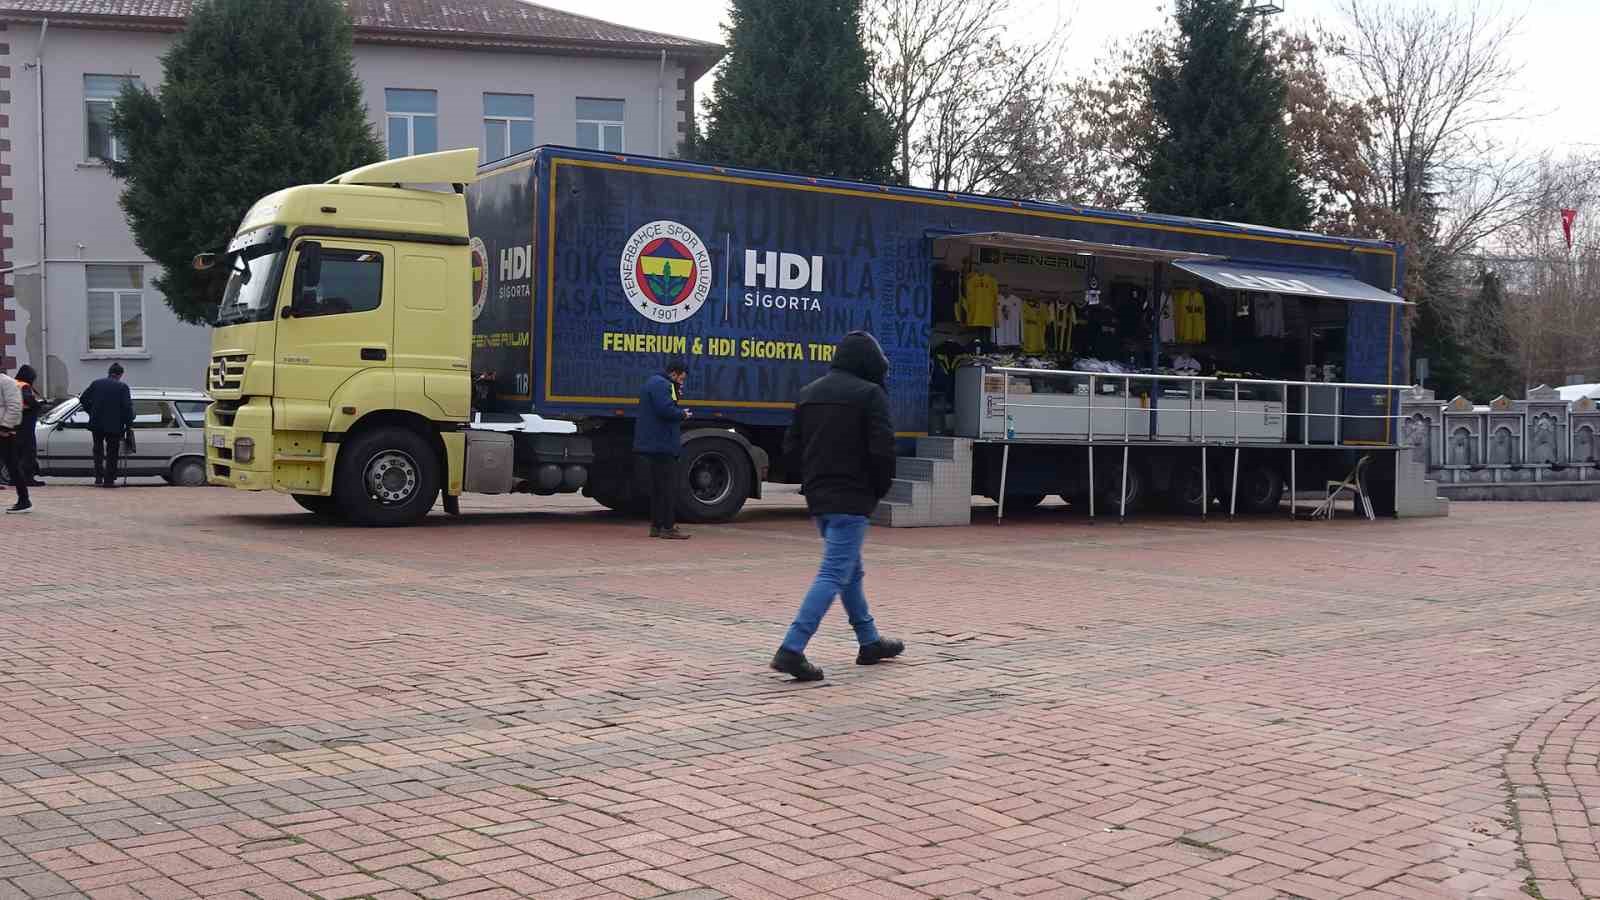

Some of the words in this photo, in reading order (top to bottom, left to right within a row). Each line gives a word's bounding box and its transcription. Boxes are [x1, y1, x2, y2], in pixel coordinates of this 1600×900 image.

[500, 245, 532, 282] HDI
[623, 224, 662, 298] FENERBAHÇE
[666, 224, 698, 249] SPOR
[744, 249, 823, 292] HDI
[1008, 254, 1089, 271] FENERIU
[652, 307, 678, 320] 1907
[744, 291, 821, 312] SİGORTA
[602, 332, 686, 354] FENERIUM
[690, 339, 703, 355] &
[708, 338, 735, 357] HDI
[740, 336, 804, 361] SİGORTA
